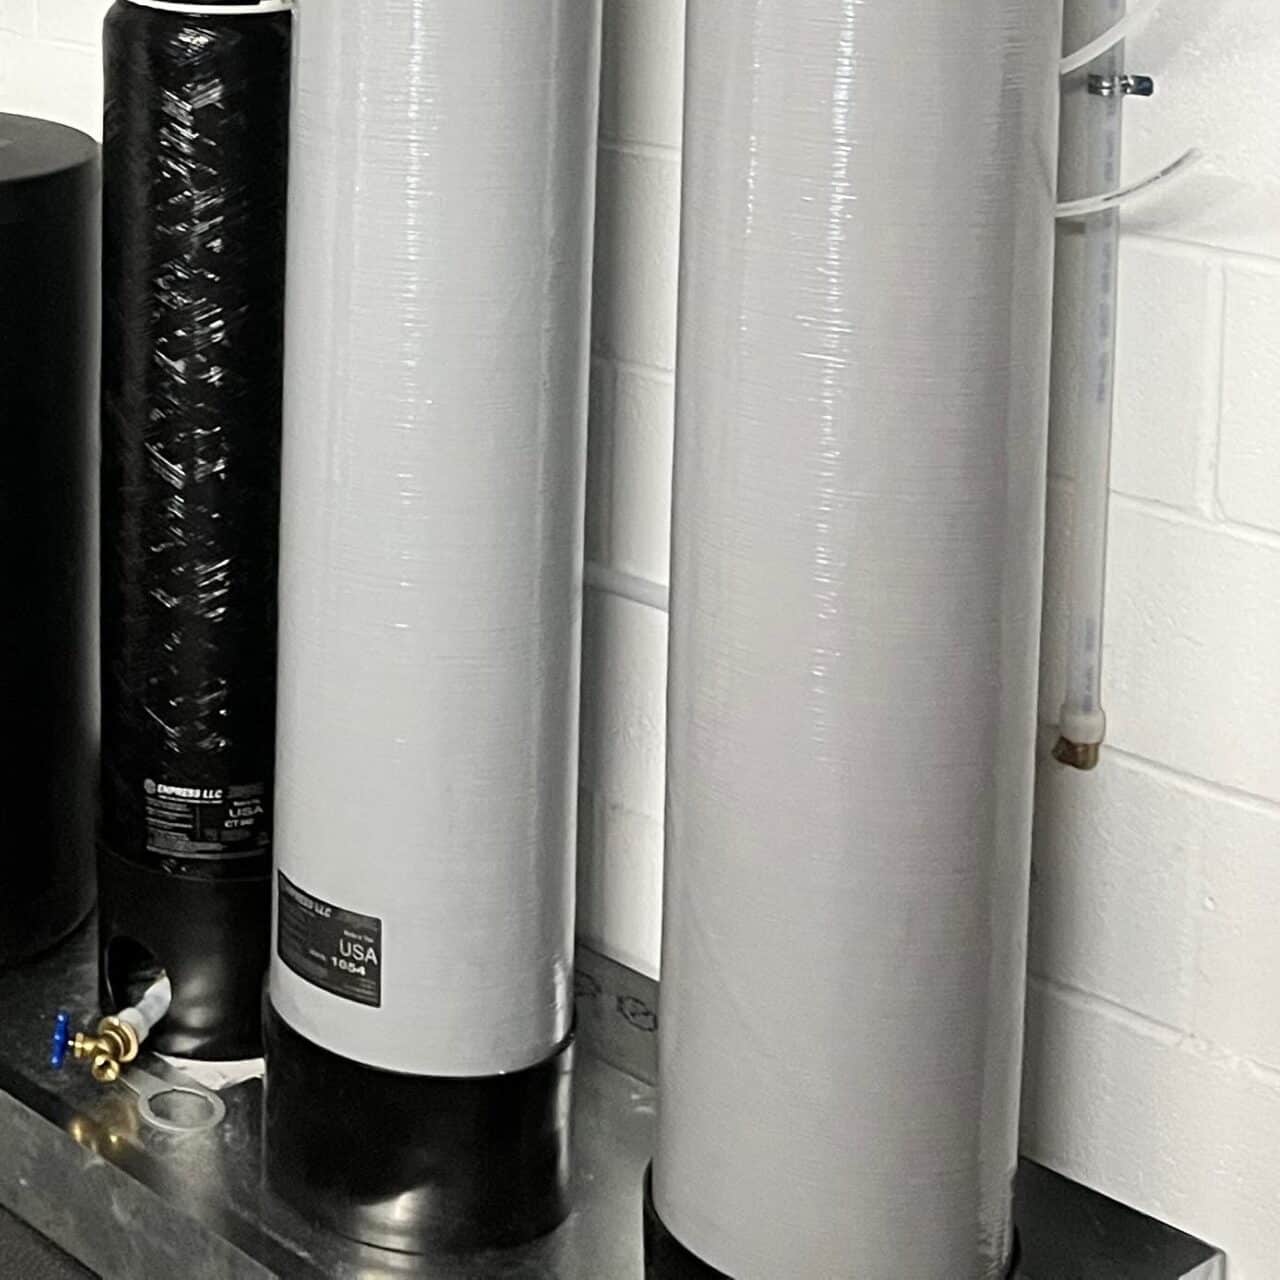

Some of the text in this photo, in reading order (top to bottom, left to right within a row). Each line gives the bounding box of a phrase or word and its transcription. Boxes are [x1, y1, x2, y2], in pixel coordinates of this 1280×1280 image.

[202, 788, 223, 799] LLC
[228, 805, 264, 818] USA
[339, 938, 378, 965] USA
